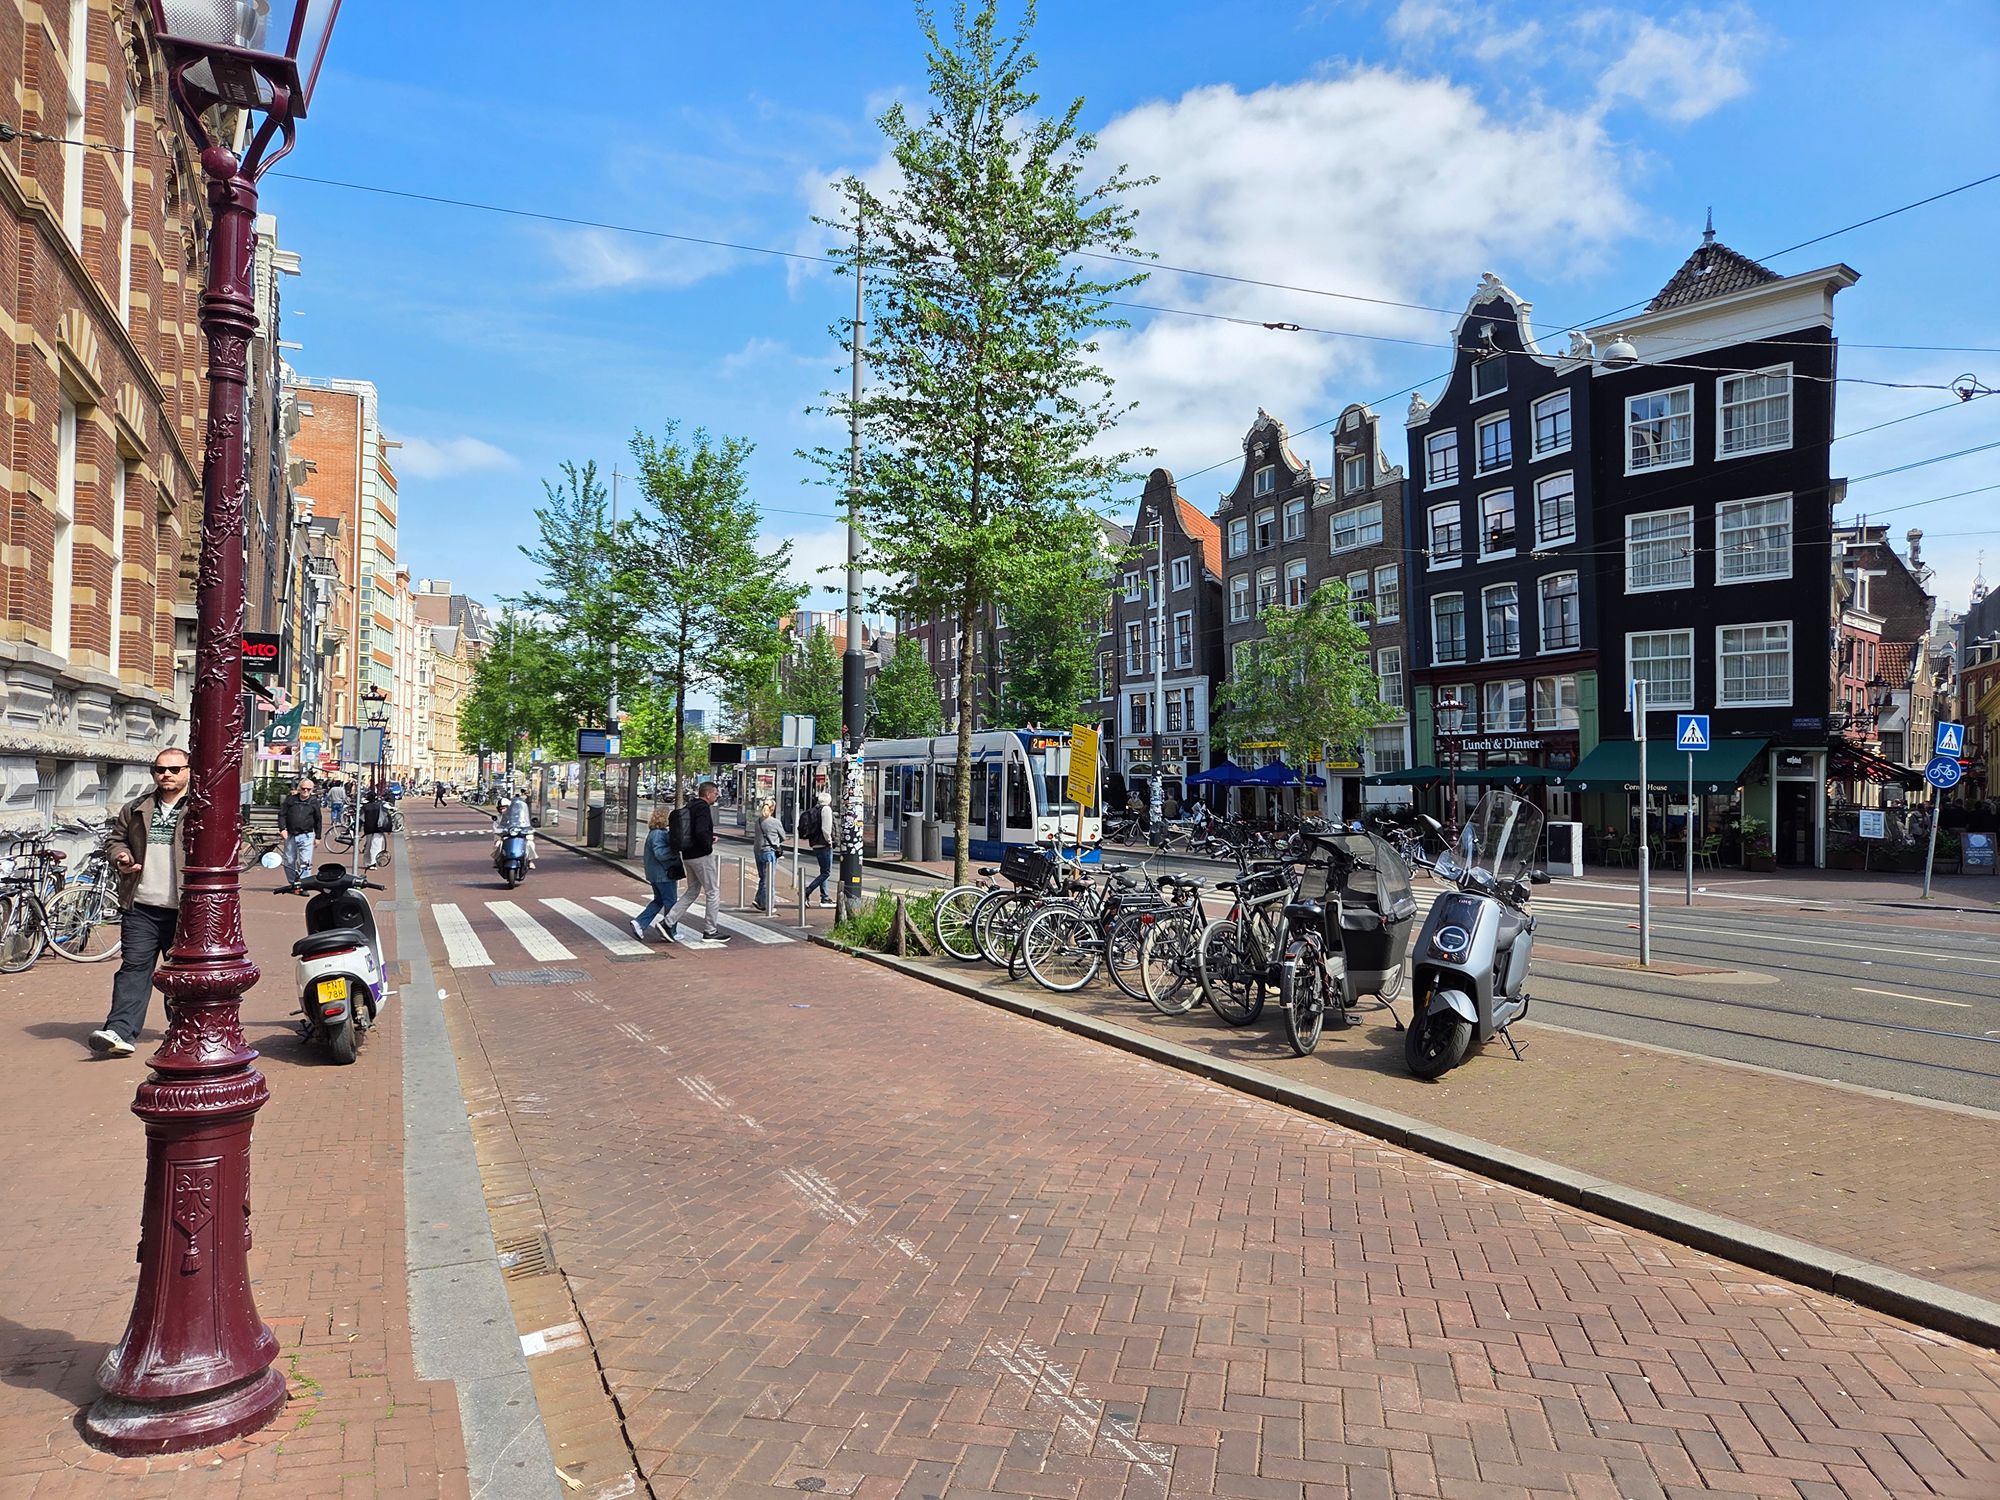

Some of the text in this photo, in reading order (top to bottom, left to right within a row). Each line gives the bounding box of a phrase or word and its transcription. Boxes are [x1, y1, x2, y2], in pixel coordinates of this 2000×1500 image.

[241, 639, 278, 657] Arto
[1032, 738, 1038, 748] 2
[1462, 737, 1540, 750] Lunch & Dinner
[1647, 783, 1668, 791] House
